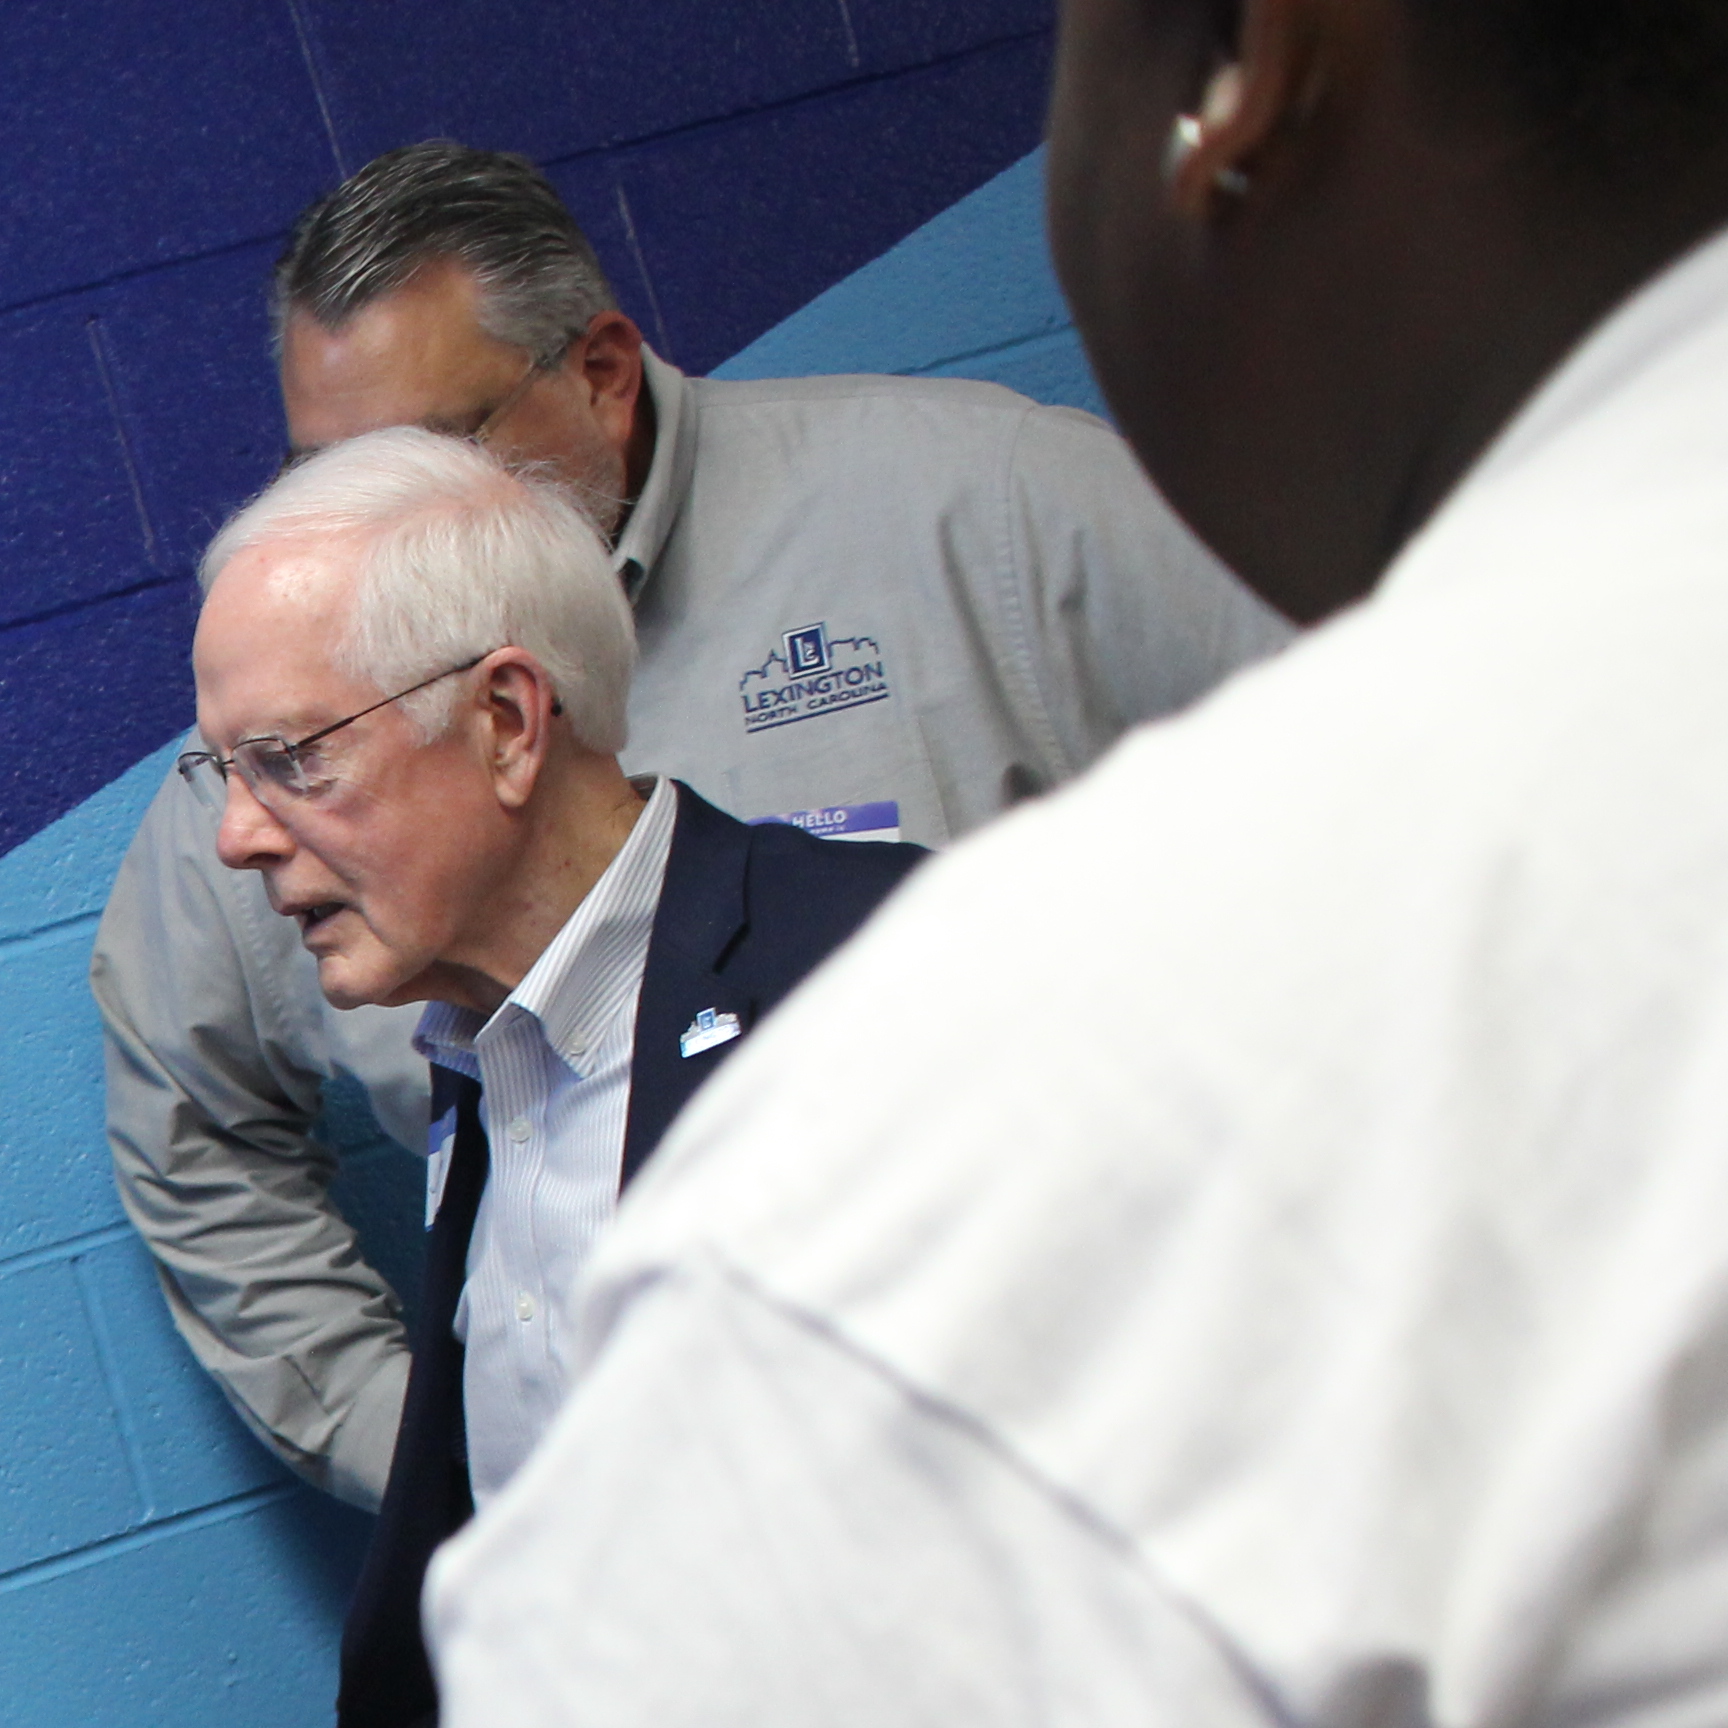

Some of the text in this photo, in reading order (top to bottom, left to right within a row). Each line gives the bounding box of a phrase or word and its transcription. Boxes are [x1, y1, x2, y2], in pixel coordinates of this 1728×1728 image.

[741, 661, 884, 713] LEXINGTON
[745, 682, 888, 725] NORTH CAROLINA
[792, 810, 847, 828] HELLO
